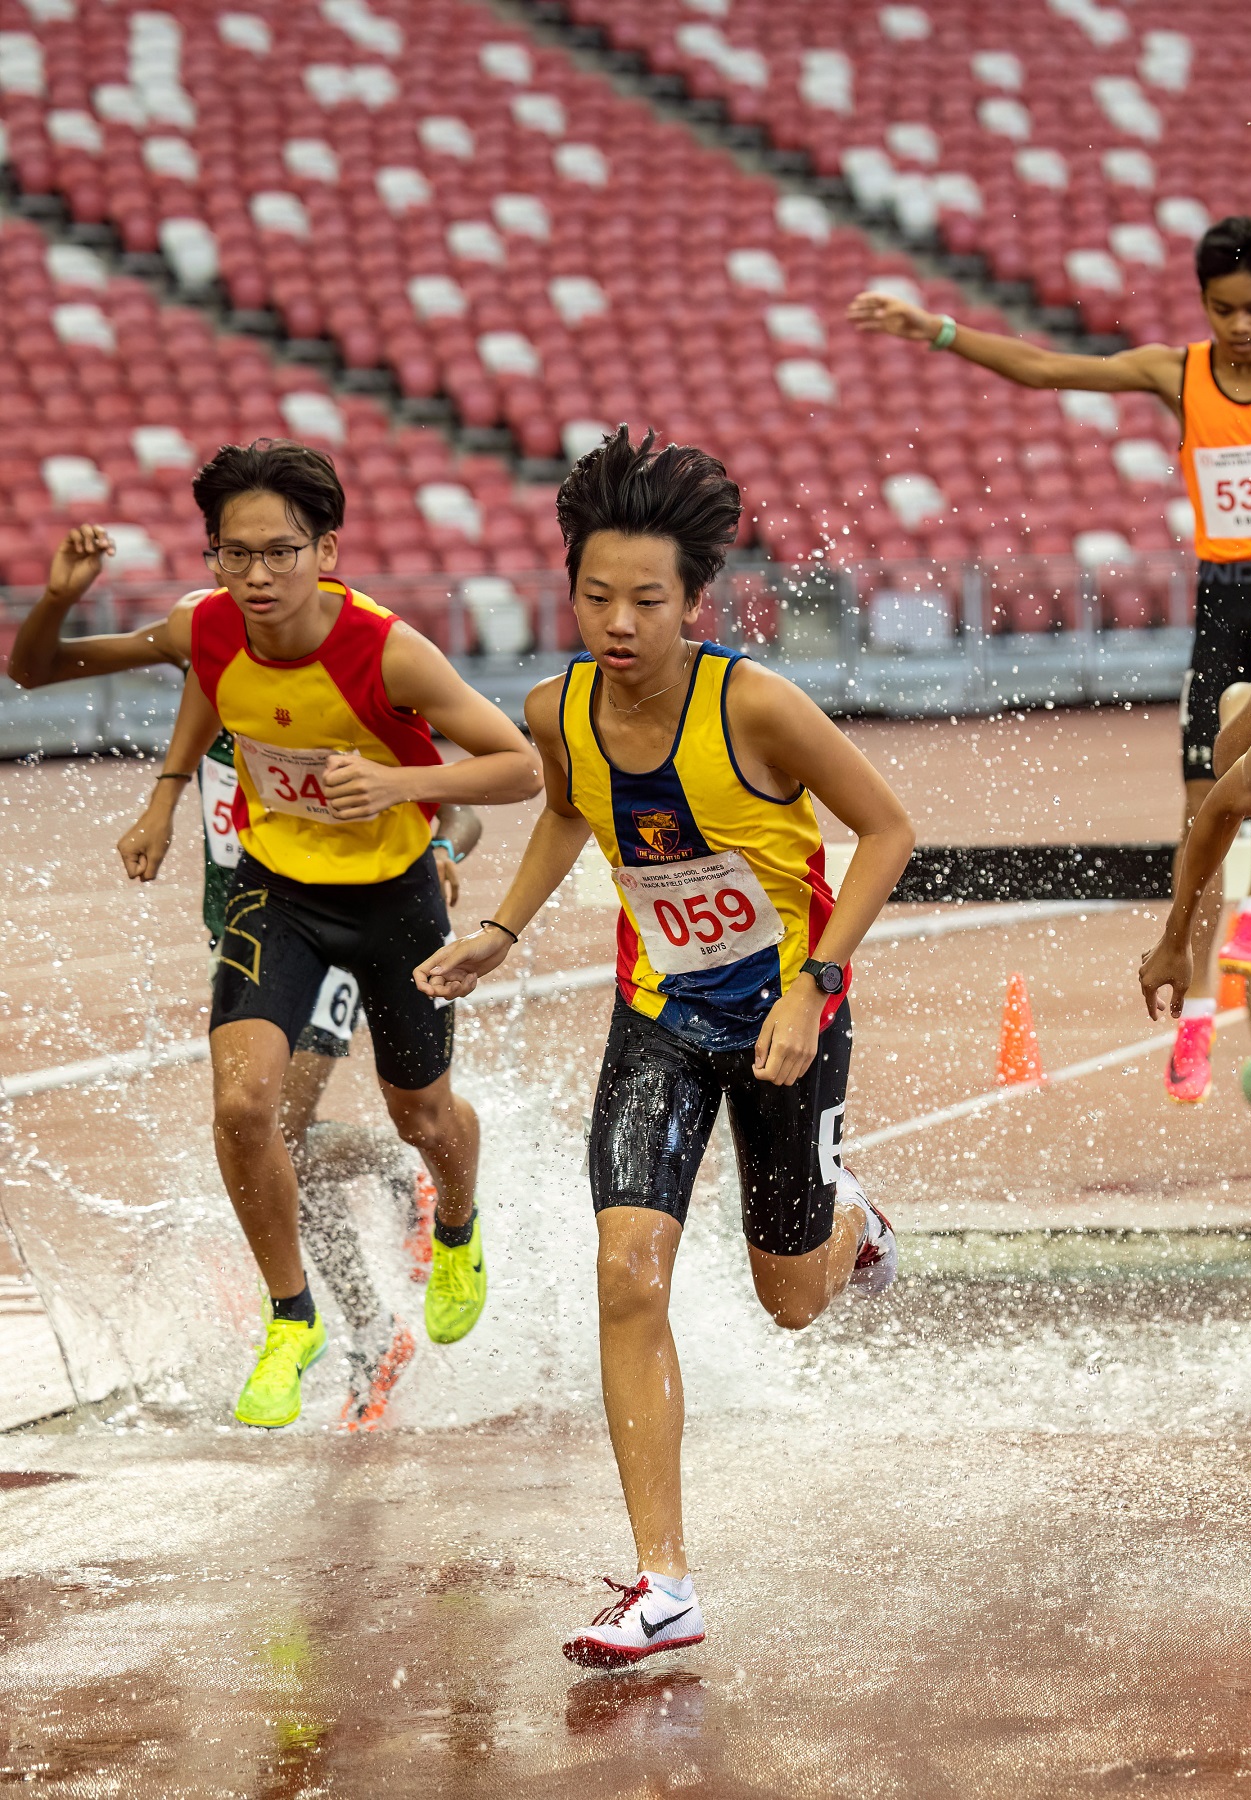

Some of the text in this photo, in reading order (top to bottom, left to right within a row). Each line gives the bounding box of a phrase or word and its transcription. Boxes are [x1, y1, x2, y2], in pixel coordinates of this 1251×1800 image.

[640, 881, 661, 889] TRACK
[666, 880, 683, 888] FIELD
[683, 867, 736, 885] CHAMPIONSHIPS
[642, 864, 725, 882] NATIONAL SCHOOL GAMES
[653, 888, 757, 947] 059
[706, 942, 727, 955] BOYS
[329, 983, 352, 1027] 6
